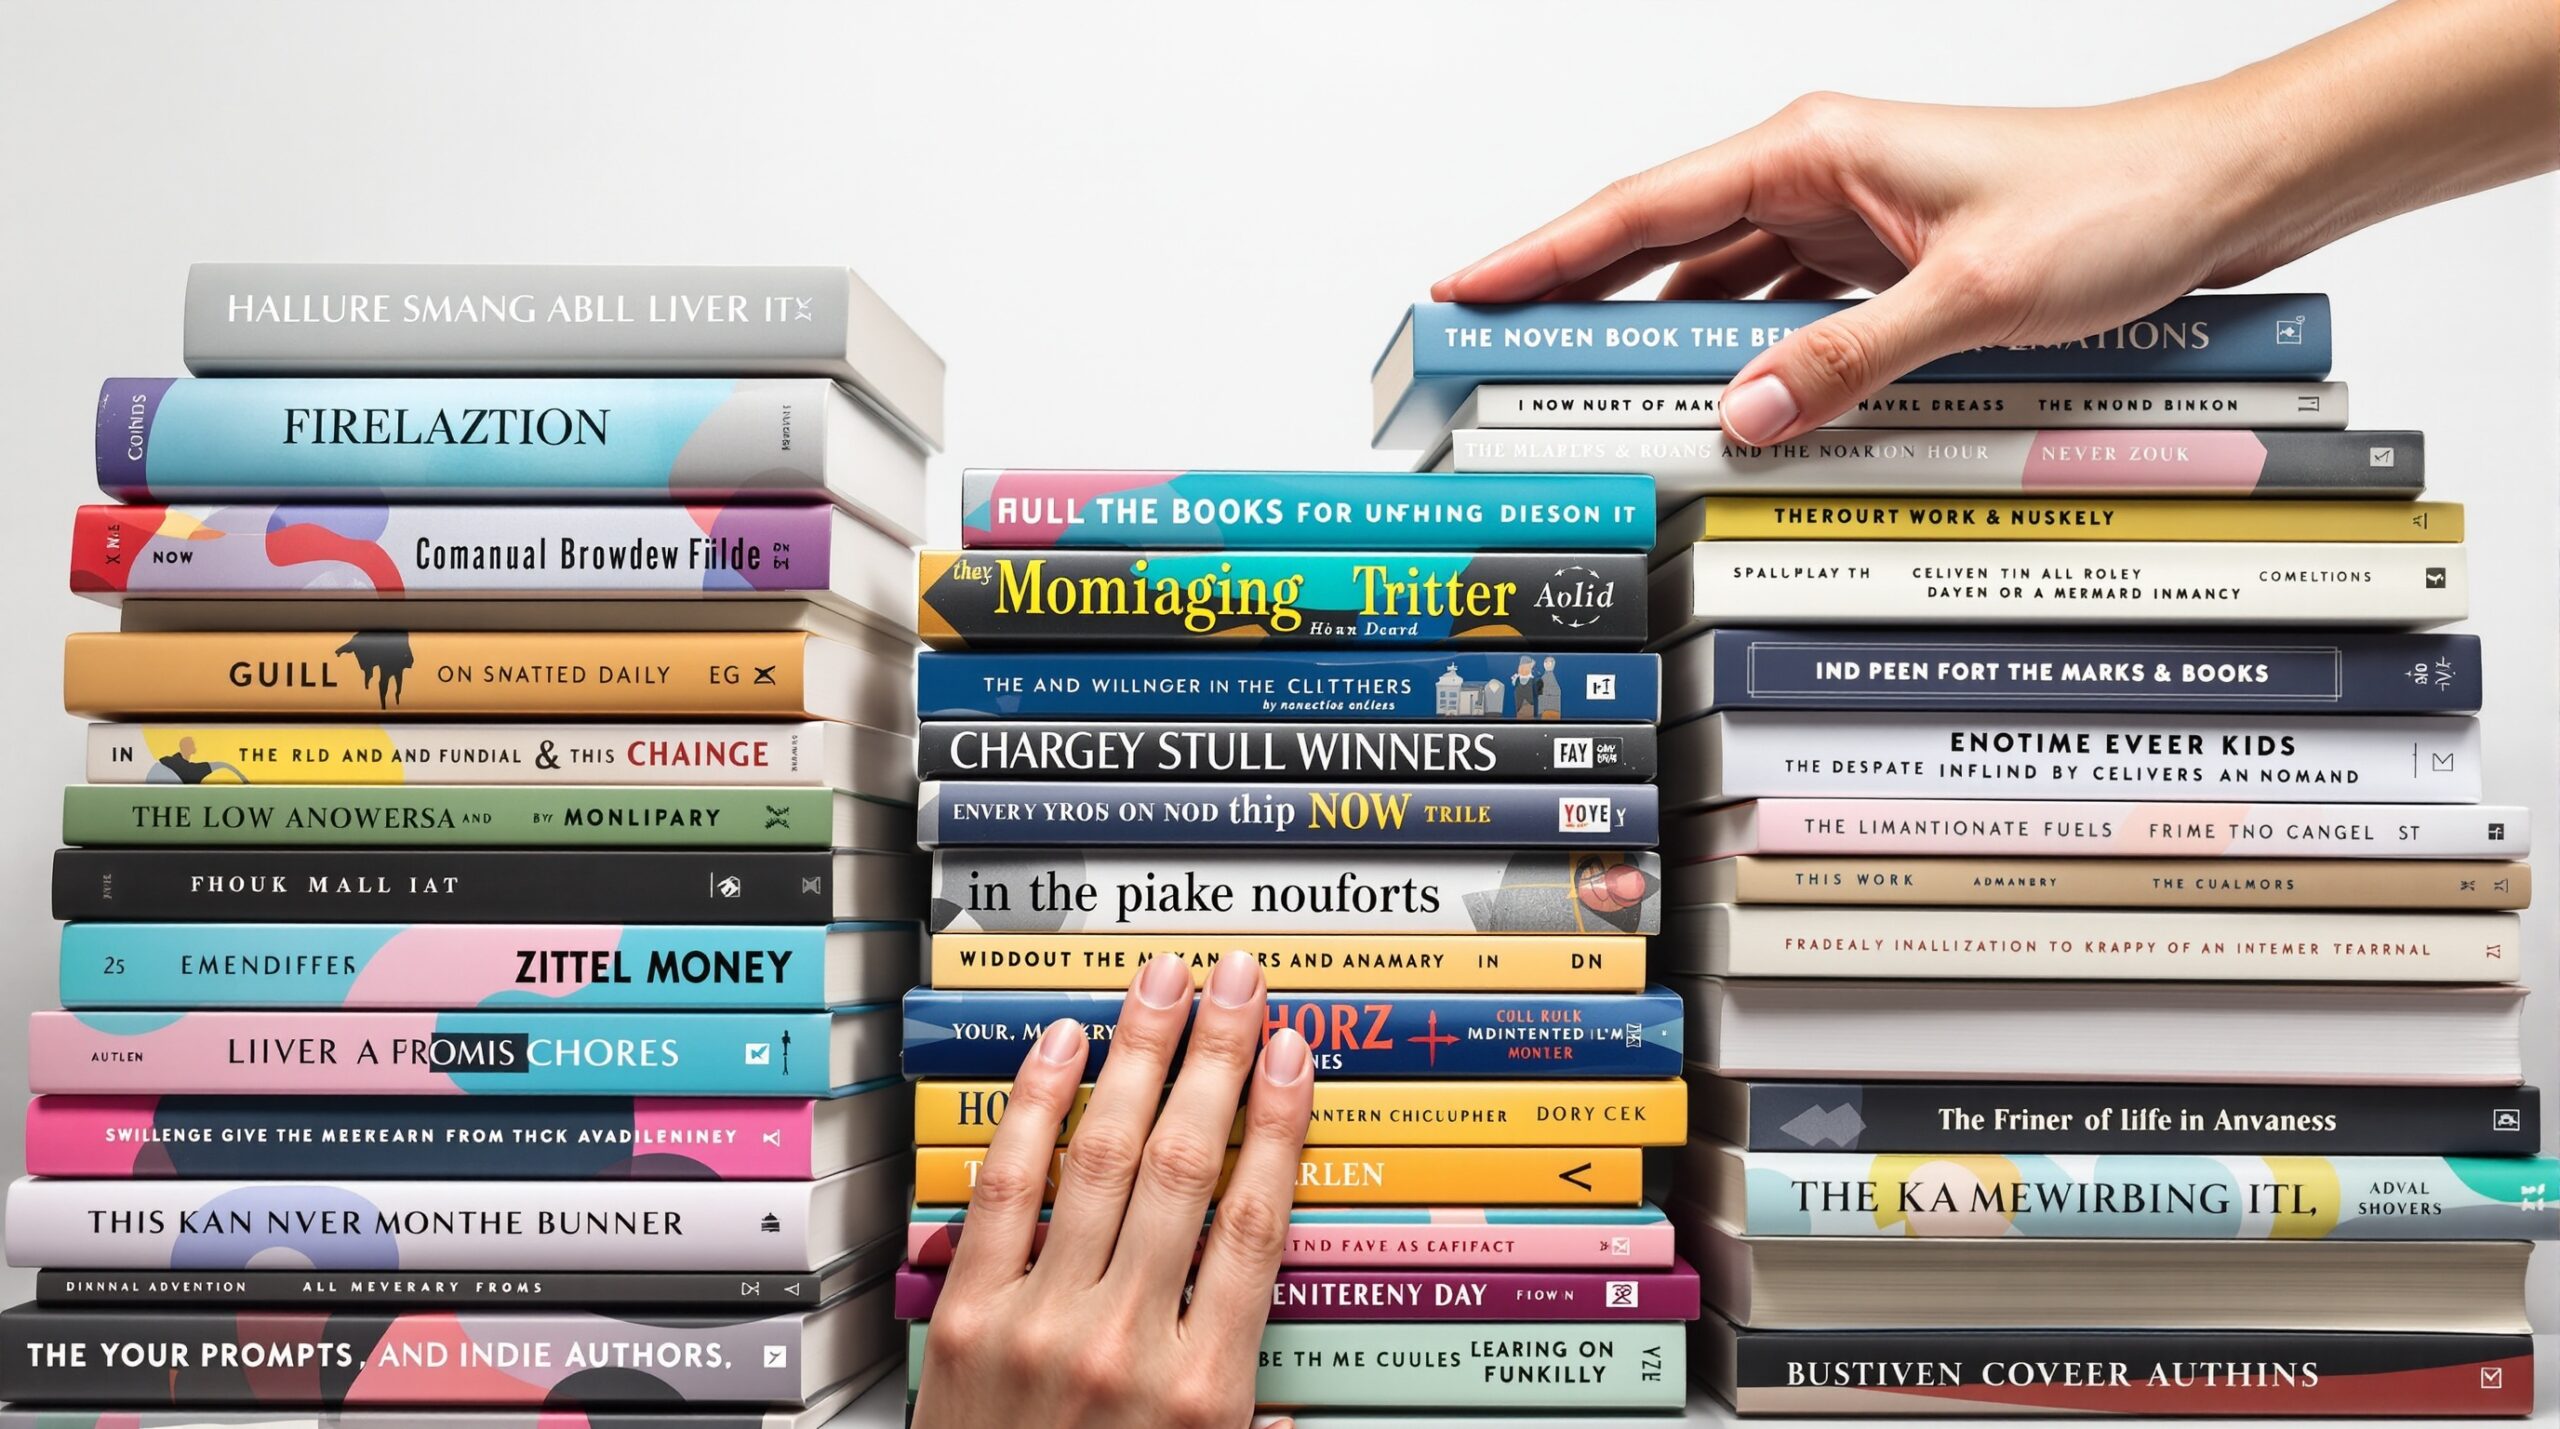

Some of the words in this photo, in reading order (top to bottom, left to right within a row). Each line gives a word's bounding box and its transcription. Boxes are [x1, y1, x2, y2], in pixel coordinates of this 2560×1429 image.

[229, 294, 390, 322] HALLURE
[404, 294, 535, 322] SMANG
[548, 294, 634, 322] ABLL
[650, 295, 749, 322] LIVER
[1445, 328, 1492, 347] THE
[1504, 328, 1593, 347] NOVEN
[1606, 328, 1679, 347] BOOK
[1690, 328, 1739, 347] THE
[1533, 399, 1574, 411] NOW
[1584, 399, 1631, 411] NURT
[1642, 399, 1666, 411] OF
[2039, 399, 2072, 411] THE
[2084, 399, 2152, 411] KNOND
[2165, 399, 2238, 412] BINKON
[283, 408, 610, 446] FIRELAZTION
[1722, 444, 1761, 458] AND
[1772, 445, 1809, 458] THE
[2042, 446, 2116, 461] NEVER
[2129, 446, 2189, 462] ZOUK
[1096, 498, 1158, 524] THE
[1172, 498, 1283, 525] BOOKS
[1297, 502, 1352, 523] FOR
[1500, 504, 1600, 524] DIESON
[1614, 505, 1636, 524] IT
[1775, 508, 1899, 525] THEROURT
[1910, 509, 1976, 525] WORK
[2011, 509, 2114, 526] NUSKELY
[154, 552, 193, 564] NOW
[416, 537, 545, 570] Comanual
[561, 537, 678, 570] Browdew
[1913, 567, 1988, 579] CELIVEN
[2001, 568, 2030, 580] TIN
[2042, 568, 2073, 580] ALL
[2084, 568, 2142, 580] ROLEY
[2259, 570, 2372, 583] COMELTIONS
[1353, 564, 1517, 617] Tritter
[1928, 586, 1988, 599] DAYEN
[1999, 587, 2023, 599] OR
[2054, 587, 2142, 600] MERMARD
[2153, 588, 2241, 600] INMANCY
[229, 661, 338, 688] GUILL
[438, 666, 472, 683] ON
[483, 665, 586, 684] SNATTED
[599, 665, 671, 685] DAILY
[1816, 661, 1860, 679] IND
[1869, 661, 1928, 680] PEEN
[1938, 662, 2000, 681] FORT
[2008, 663, 2053, 681] THE
[2061, 662, 2145, 682] MARKS
[2182, 663, 2269, 683] BOOKS
[983, 677, 1023, 693] THE
[1033, 677, 1080, 693] AND
[1210, 679, 1229, 693] IN
[1238, 679, 1275, 693] THE
[950, 730, 1146, 770] CHARGEY
[1158, 731, 1285, 771] STULL
[1297, 732, 1497, 772] WINNERS
[1951, 731, 2090, 754] ENOTIME
[2106, 733, 2204, 756] EVEER
[2222, 734, 2296, 756] KIDS
[112, 747, 134, 762] IN
[239, 747, 278, 762] THE
[342, 748, 382, 762] AND
[391, 748, 430, 763] AND
[440, 748, 521, 763] FUNDIAL
[535, 739, 561, 770] &
[570, 749, 615, 764] THIS
[627, 740, 769, 767] CHAINGE
[1785, 760, 1820, 773] THE
[1832, 760, 1924, 775] DESPATE
[1940, 763, 2037, 779] INFLIND
[2052, 765, 2078, 780] BY
[2093, 766, 2203, 782] CELIVERS
[2219, 767, 2248, 783] AN
[2261, 768, 2359, 784] NOMAND
[132, 806, 191, 828] THE
[203, 806, 275, 829] LOW
[462, 812, 491, 824] AND
[564, 808, 720, 827] MONLIPARY
[1119, 803, 1155, 821] ON
[1164, 803, 1219, 822] NOD
[1229, 793, 1295, 832] thip
[1308, 792, 1412, 831] NOW
[1424, 805, 1491, 823] TRILE
[1805, 819, 1845, 834] THE
[1859, 819, 2028, 836] LIMANTIONATE
[2044, 821, 2112, 837] FUELS
[2150, 823, 2215, 839] FRIME
[2286, 824, 2374, 840] CANGEL
[191, 876, 287, 893] FHOUK
[308, 876, 391, 893] MALL
[1795, 873, 1842, 885] THIS
[1857, 874, 1914, 886] WORK
[2153, 878, 2184, 889] THE
[2195, 878, 2295, 890] CUALMORS
[968, 870, 1011, 912] in
[1030, 870, 1098, 912] the
[1115, 871, 1234, 923] piake
[1251, 871, 1440, 914] nouforts
[1785, 938, 1884, 951] FRADEALY
[1895, 939, 2037, 952] INALLIZATION
[2049, 941, 2073, 953] TO
[2085, 941, 2157, 954] KRAPPY
[2168, 942, 2191, 954] OF
[2201, 942, 2224, 954] AN
[515, 950, 631, 983] ZITTEL
[646, 950, 793, 983] MONEY
[960, 951, 1071, 967] WIDDOUT
[1084, 951, 1125, 967] THE
[1290, 953, 1333, 968] AND
[1343, 953, 1444, 968] ANAMARY
[1478, 954, 1498, 968] IN
[526, 1038, 679, 1067] CHORES
[1537, 1106, 1594, 1121] DORY
[1604, 1106, 1646, 1121] CEK
[1938, 1107, 1985, 1130] The
[1994, 1107, 2073, 1131] Friner
[2084, 1107, 2112, 1131] of
[2180, 1108, 2204, 1131] in
[2213, 1109, 2336, 1132] Anvaness
[105, 1128, 212, 1143] SWILLENGE
[222, 1128, 267, 1143] GIVE
[276, 1129, 312, 1143] THE
[446, 1129, 503, 1143] FROM
[1791, 1181, 1878, 1212] THE
[2370, 1181, 2430, 1195] ADVAL
[2358, 1202, 2442, 1216] SHOVERS
[88, 1210, 165, 1234] THIS
[180, 1210, 251, 1234] KAN
[269, 1210, 361, 1235] NVER
[375, 1210, 522, 1235] MONTHE
[538, 1211, 683, 1236] BUNNER
[1397, 1240, 1419, 1252] AS
[149, 1281, 246, 1293] ADVENTION
[302, 1281, 337, 1293] ALL
[351, 1281, 459, 1293] MEVERARY
[476, 1281, 542, 1294] FROMS
[1435, 1283, 1488, 1306] DAY
[27, 1343, 86, 1367] THE
[100, 1342, 190, 1368] YOUR
[201, 1342, 366, 1370] PROMPTS,
[378, 1342, 448, 1368] AND
[460, 1342, 551, 1368] INDIE
[564, 1341, 732, 1371] AUTHORS,
[1578, 1341, 1613, 1358] ON
[1376, 1351, 1461, 1368] CUULES
[1484, 1365, 1607, 1384] FUNKILLY
[1786, 1361, 1962, 1387] BUSTIVEN
[1981, 1361, 2132, 1387] COVEER
[2146, 1361, 2319, 1388] AUTHINS
